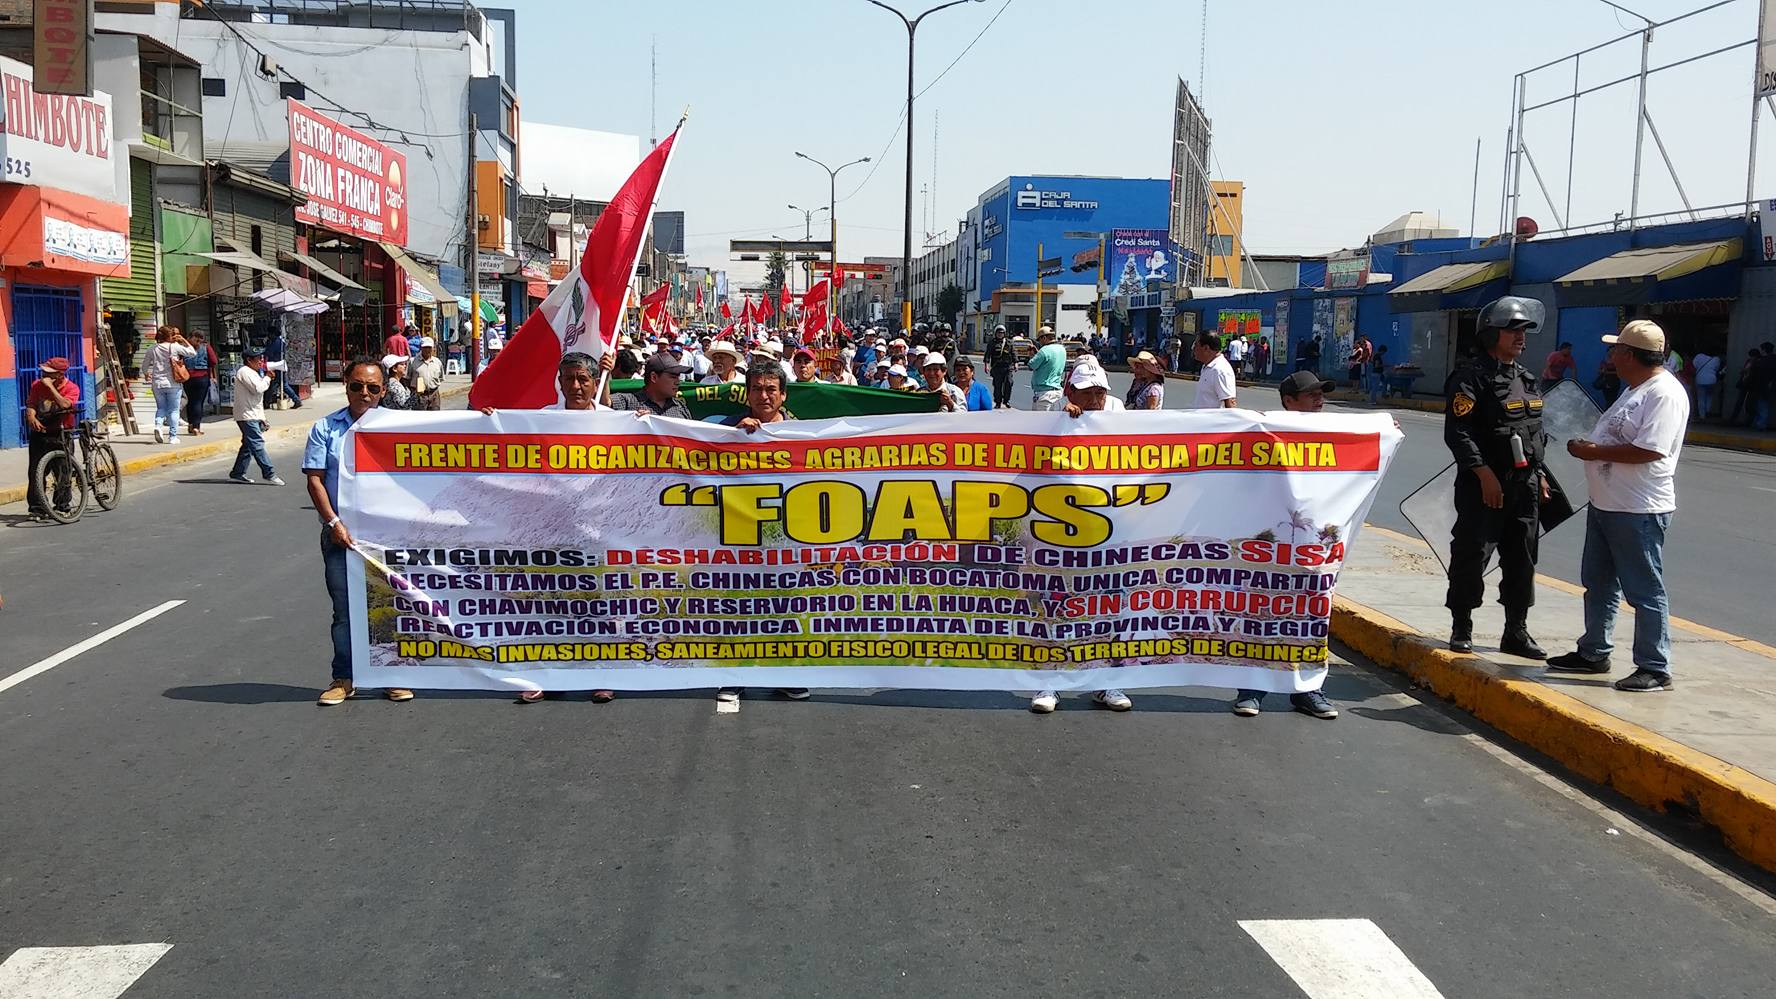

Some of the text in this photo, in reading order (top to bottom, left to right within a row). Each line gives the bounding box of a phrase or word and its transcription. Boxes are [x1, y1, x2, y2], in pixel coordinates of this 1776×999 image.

[43, 0, 76, 84] BOTE
[293, 111, 383, 177] CENTRO COMERCIAL
[6, 157, 31, 178] 525
[298, 151, 381, 217] ZONA FRANCA
[1041, 191, 1071, 199] CAJA
[1041, 200, 1098, 209] DEL SANTA
[1137, 238, 1160, 247] Santa
[423, 309, 433, 336] COP
[695, 385, 722, 401] DEL
[728, 384, 751, 407] SU
[395, 441, 1337, 471] FRENTE DE ORGANIZACIONES AGRARIAS DE LA PROVINCIA DEL SANTA
[385, 549, 597, 566] EXIGIMOS:
[606, 542, 957, 565] DESHABILITACIÓN
[977, 545, 1025, 564] DE
[1034, 543, 1229, 567] CHINECAS
[390, 567, 1339, 592] NECESITAMOS EL P.E. CHINECAS CON BOCATOMA UNICA COMPARTID
[394, 597, 450, 618] CON
[458, 598, 658, 617] CHAVIMOCHIC
[665, 598, 680, 615] Y
[688, 594, 855, 615] RESERVORIO
[862, 594, 894, 612] EN
[901, 594, 932, 612] LA
[939, 595, 1038, 617] HUACA,
[1043, 600, 1061, 618] Y
[1065, 594, 1121, 617] SIN
[401, 616, 617, 639] REACTIVACIÓN
[626, 618, 799, 635] ECONOMICA
[813, 617, 970, 634] INMEDIATA
[975, 619, 1009, 635] DE
[1016, 621, 1049, 639] LA
[1056, 616, 1210, 639] PROVINCIA
[1218, 617, 1235, 632] Y
[399, 640, 436, 658] NO
[440, 641, 495, 662] MAS
[497, 641, 653, 662] INVASIONES,
[656, 640, 825, 660] SANEAMIENTO
[828, 639, 908, 658] FISICO
[914, 641, 983, 659] LEGAL
[986, 641, 1024, 661] DE
[1026, 643, 1067, 663] LOS
[1068, 639, 1188, 661] TERRENOS
[1191, 639, 1223, 657] DE
